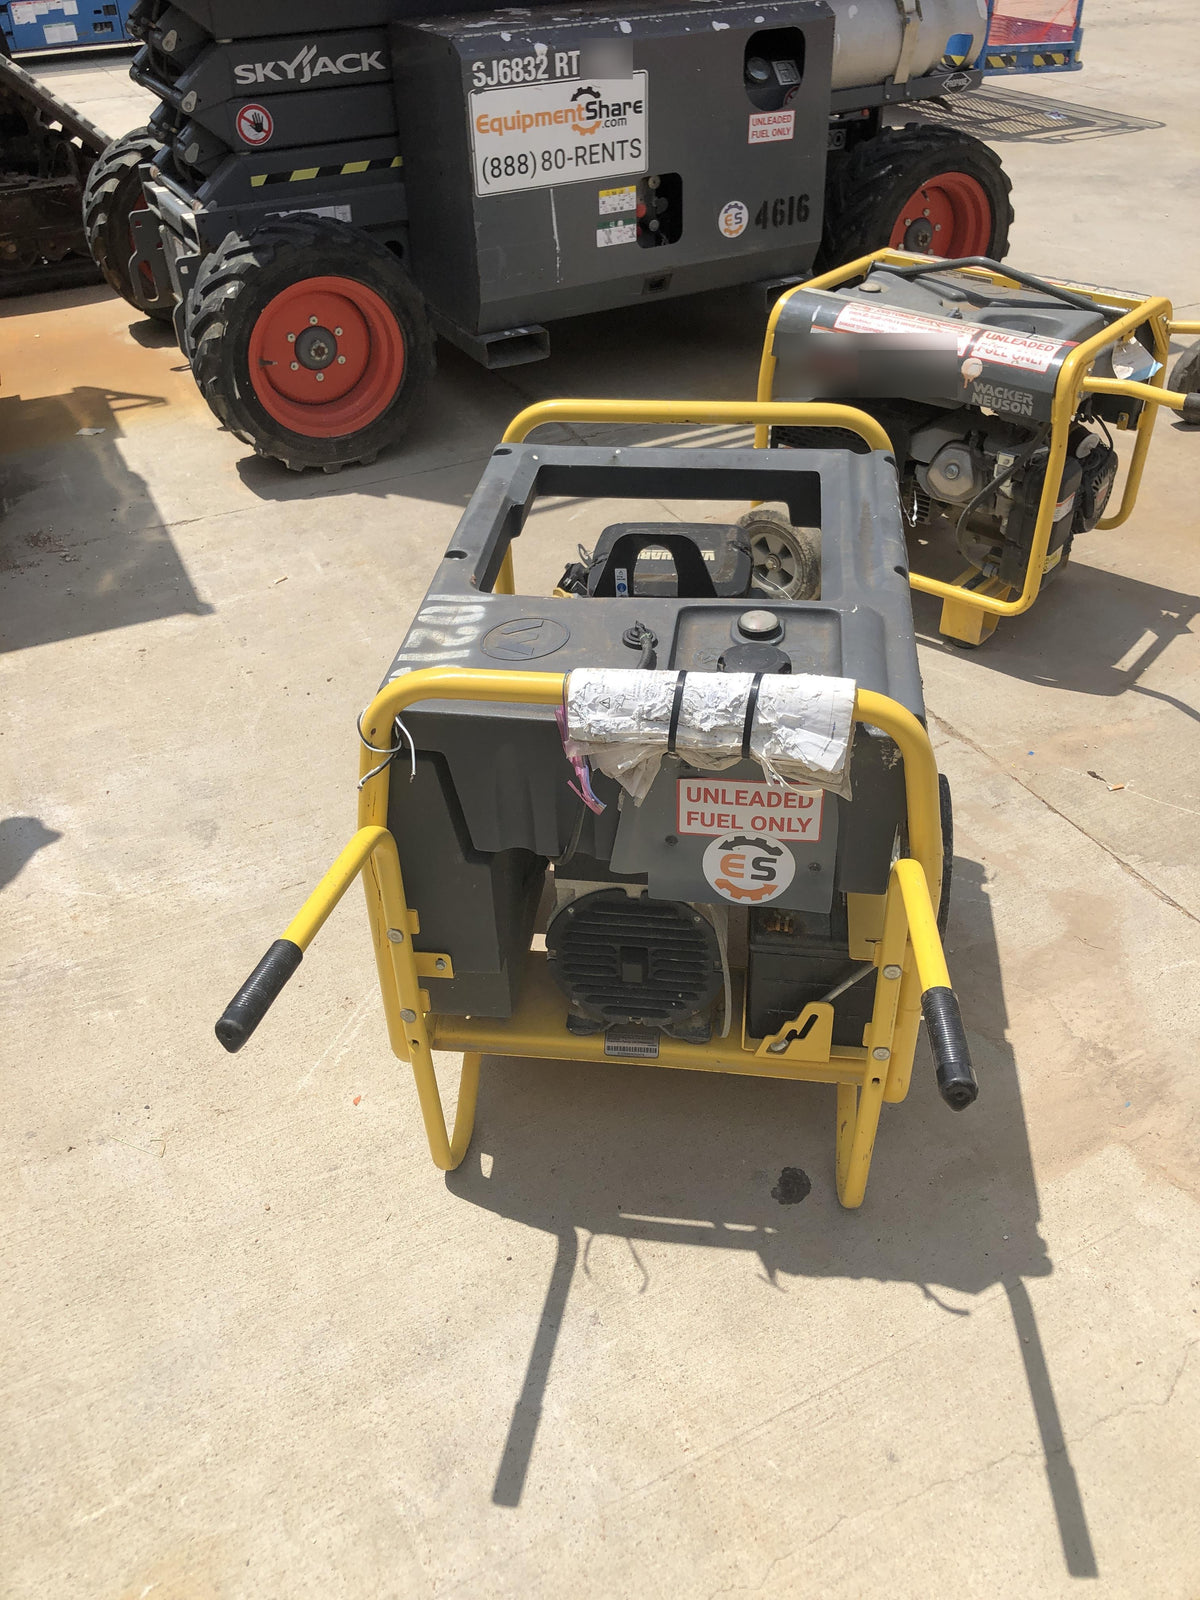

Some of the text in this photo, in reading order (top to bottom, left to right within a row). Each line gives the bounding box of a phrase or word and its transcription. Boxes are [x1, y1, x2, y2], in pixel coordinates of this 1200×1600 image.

[233, 44, 387, 85] SKYJACK
[472, 50, 581, 87] SJ6832 RT
[601, 117, 628, 129] .com
[751, 114, 792, 126] UNLEADED
[751, 126, 792, 139] FUEL ONLY
[482, 138, 642, 185] (888) 80-RENTS
[754, 193, 811, 230] 4616
[985, 332, 1055, 352] UNLEADED
[971, 392, 1034, 417] NEUSON
[973, 380, 1034, 405] WACKER
[686, 786, 814, 810] UNLEADED
[686, 811, 813, 833] FUEL ONLY
[719, 853, 778, 882] ES
